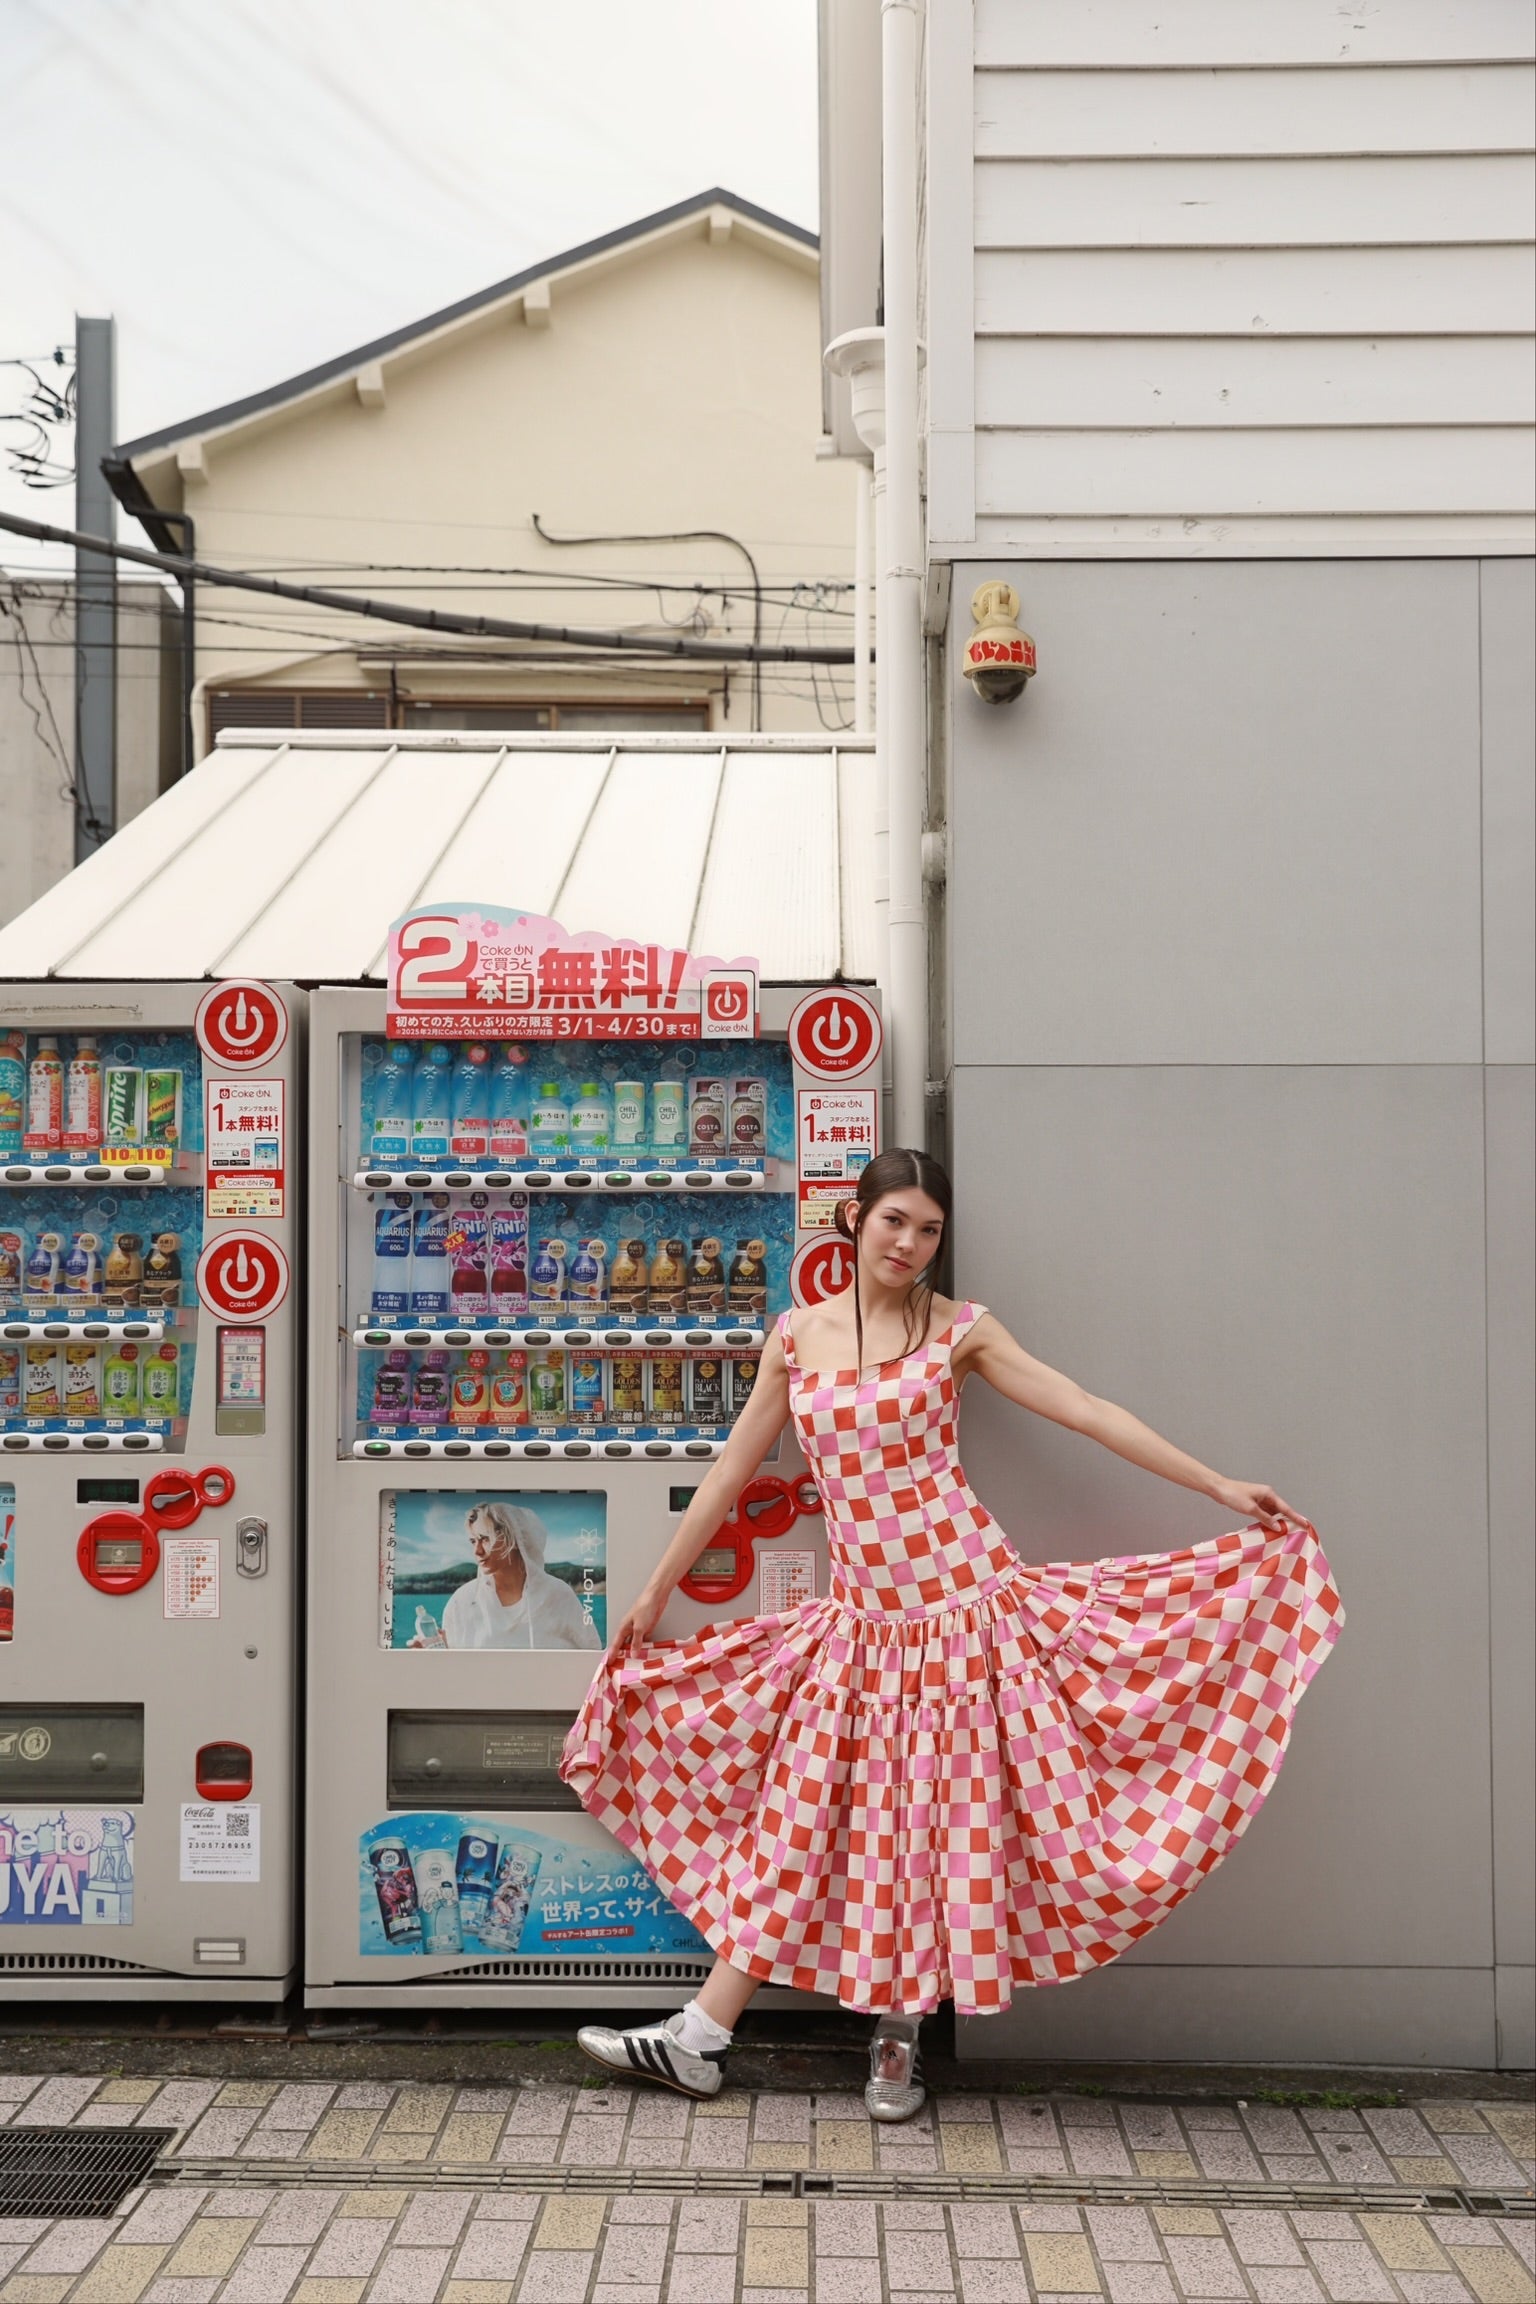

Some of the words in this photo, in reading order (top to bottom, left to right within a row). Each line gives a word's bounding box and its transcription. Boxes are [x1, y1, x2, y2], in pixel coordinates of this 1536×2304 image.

[480, 945, 511, 956] Coke
[401, 919, 468, 999] 2
[476, 975, 529, 1004] 本目
[537, 947, 688, 1010] 無料!
[480, 957, 533, 971] で買うと
[395, 1016, 553, 1028] 初めての方、久しぶりの方限定
[707, 1024, 731, 1033] Coke
[231, 1090, 254, 1098] Coke
[109, 1072, 128, 1137] Sprite
[259, 1179, 273, 1188] Pay
[377, 1226, 410, 1236] AQUARIUS
[415, 1226, 448, 1237] AQUARIUS
[453, 1220, 487, 1234] FANTA
[492, 1220, 526, 1235] FANTA
[695, 1383, 720, 1393] BLACK
[735, 1383, 754, 1393] BLAC
[623, 1411, 643, 1422] 微糖
[663, 1411, 682, 1422] 微糖
[582, 1568, 594, 1626] LOHAS
[52, 1824, 92, 1856] to
